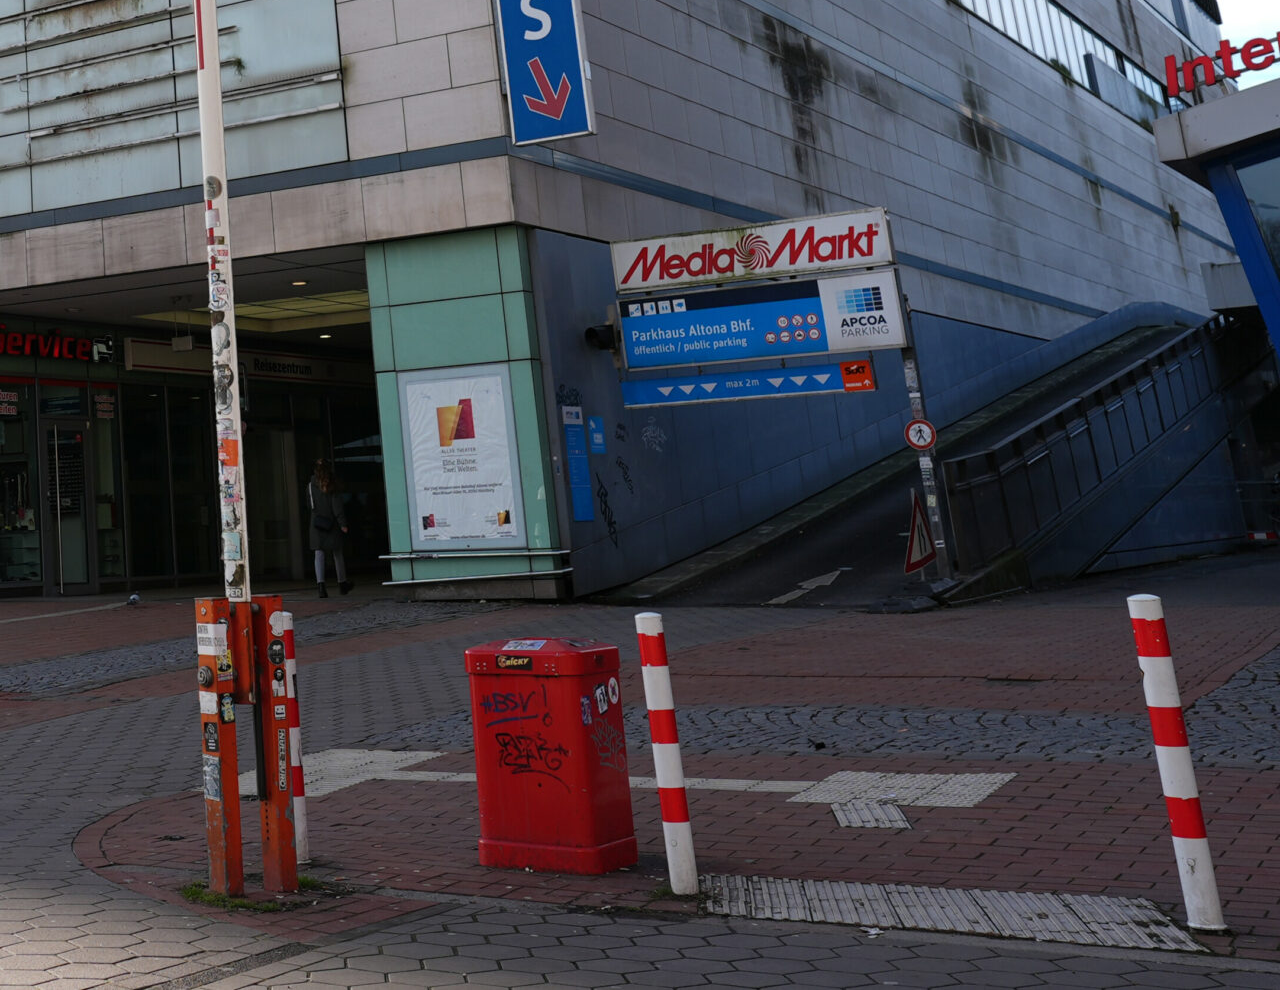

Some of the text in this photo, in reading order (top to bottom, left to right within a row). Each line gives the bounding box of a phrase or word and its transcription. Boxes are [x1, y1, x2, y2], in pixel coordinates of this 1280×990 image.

[1164, 31, 1280, 97] Inte
[621, 243, 737, 285] Media
[841, 314, 887, 328] APCOA
[632, 319, 755, 342] Parkhaus Altona Bhf.
[841, 325, 890, 338] PARKING
[634, 343, 675, 355] öffentlich
[684, 340, 711, 353] public
[713, 337, 748, 350] parking
[253, 359, 312, 376] Reisezentrum
[725, 378, 760, 388] max 2m
